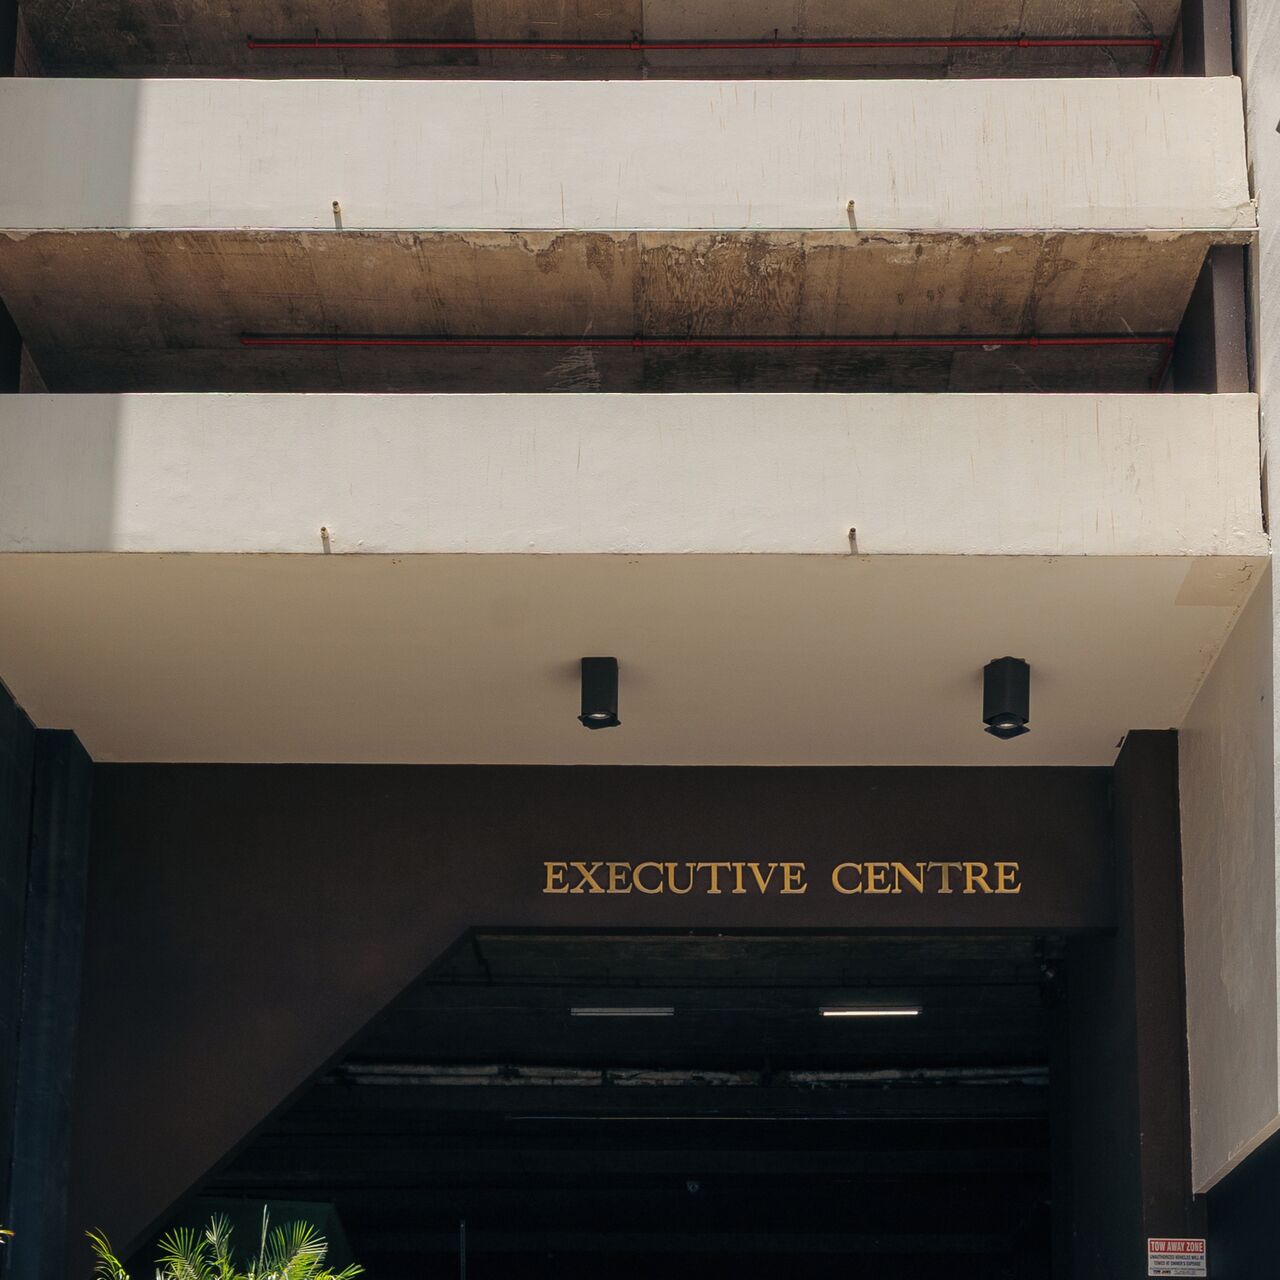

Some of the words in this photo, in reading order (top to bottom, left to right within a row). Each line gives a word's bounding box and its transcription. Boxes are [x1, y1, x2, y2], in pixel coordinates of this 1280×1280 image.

[543, 861, 808, 894] EXECUTIVE
[831, 861, 1022, 894] CENTRE
[1150, 1241, 1165, 1251] TOW
[1167, 1241, 1185, 1251] AWAY
[1186, 1241, 1203, 1251] ZONE
